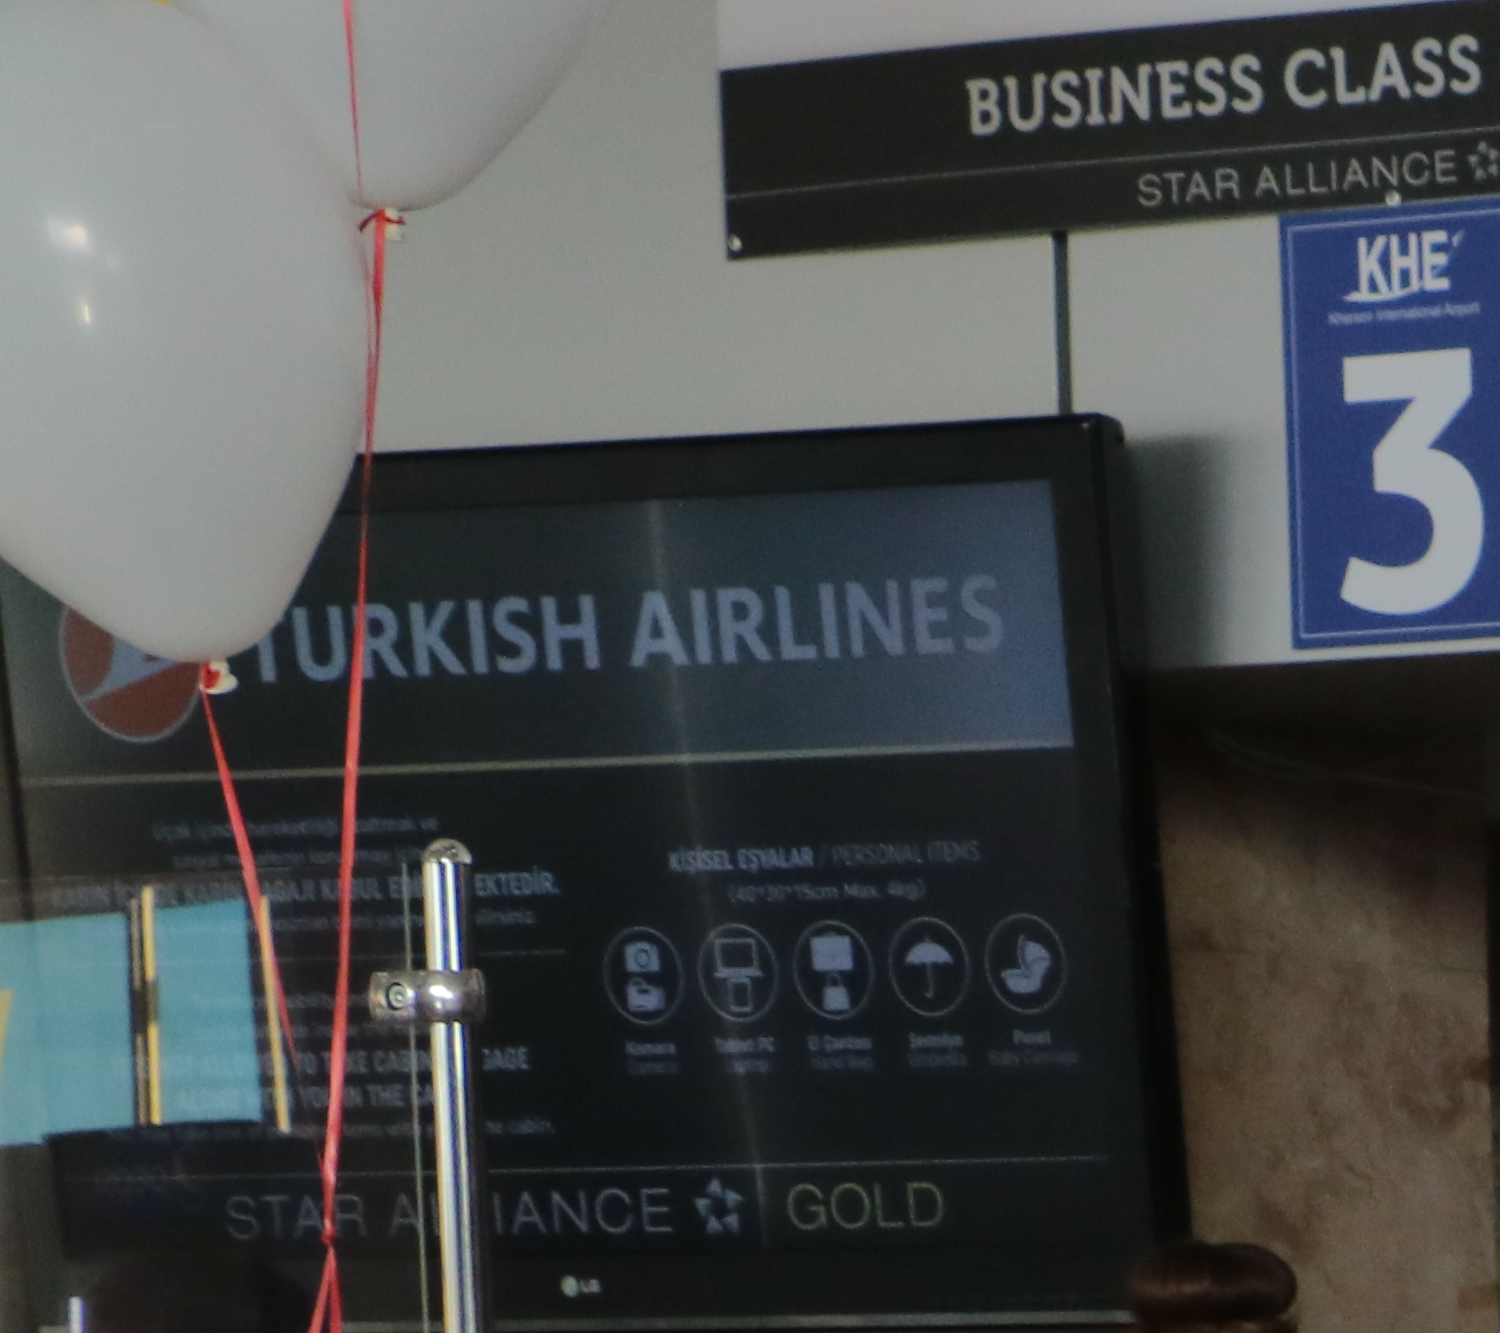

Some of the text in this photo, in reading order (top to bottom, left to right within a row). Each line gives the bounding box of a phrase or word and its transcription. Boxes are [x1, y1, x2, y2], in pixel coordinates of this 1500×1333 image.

[965, 53, 1264, 137] BUSINESS
[1284, 33, 1482, 109] CLASS
[1137, 149, 1457, 207] STAR ALLIANCE
[1356, 228, 1451, 296] KHE
[1339, 347, 1485, 615] 3
[254, 572, 1003, 684] TURKISH AIRLINES
[226, 1186, 675, 1240] STAR AIANCE
[786, 1181, 945, 1231] GOLD
